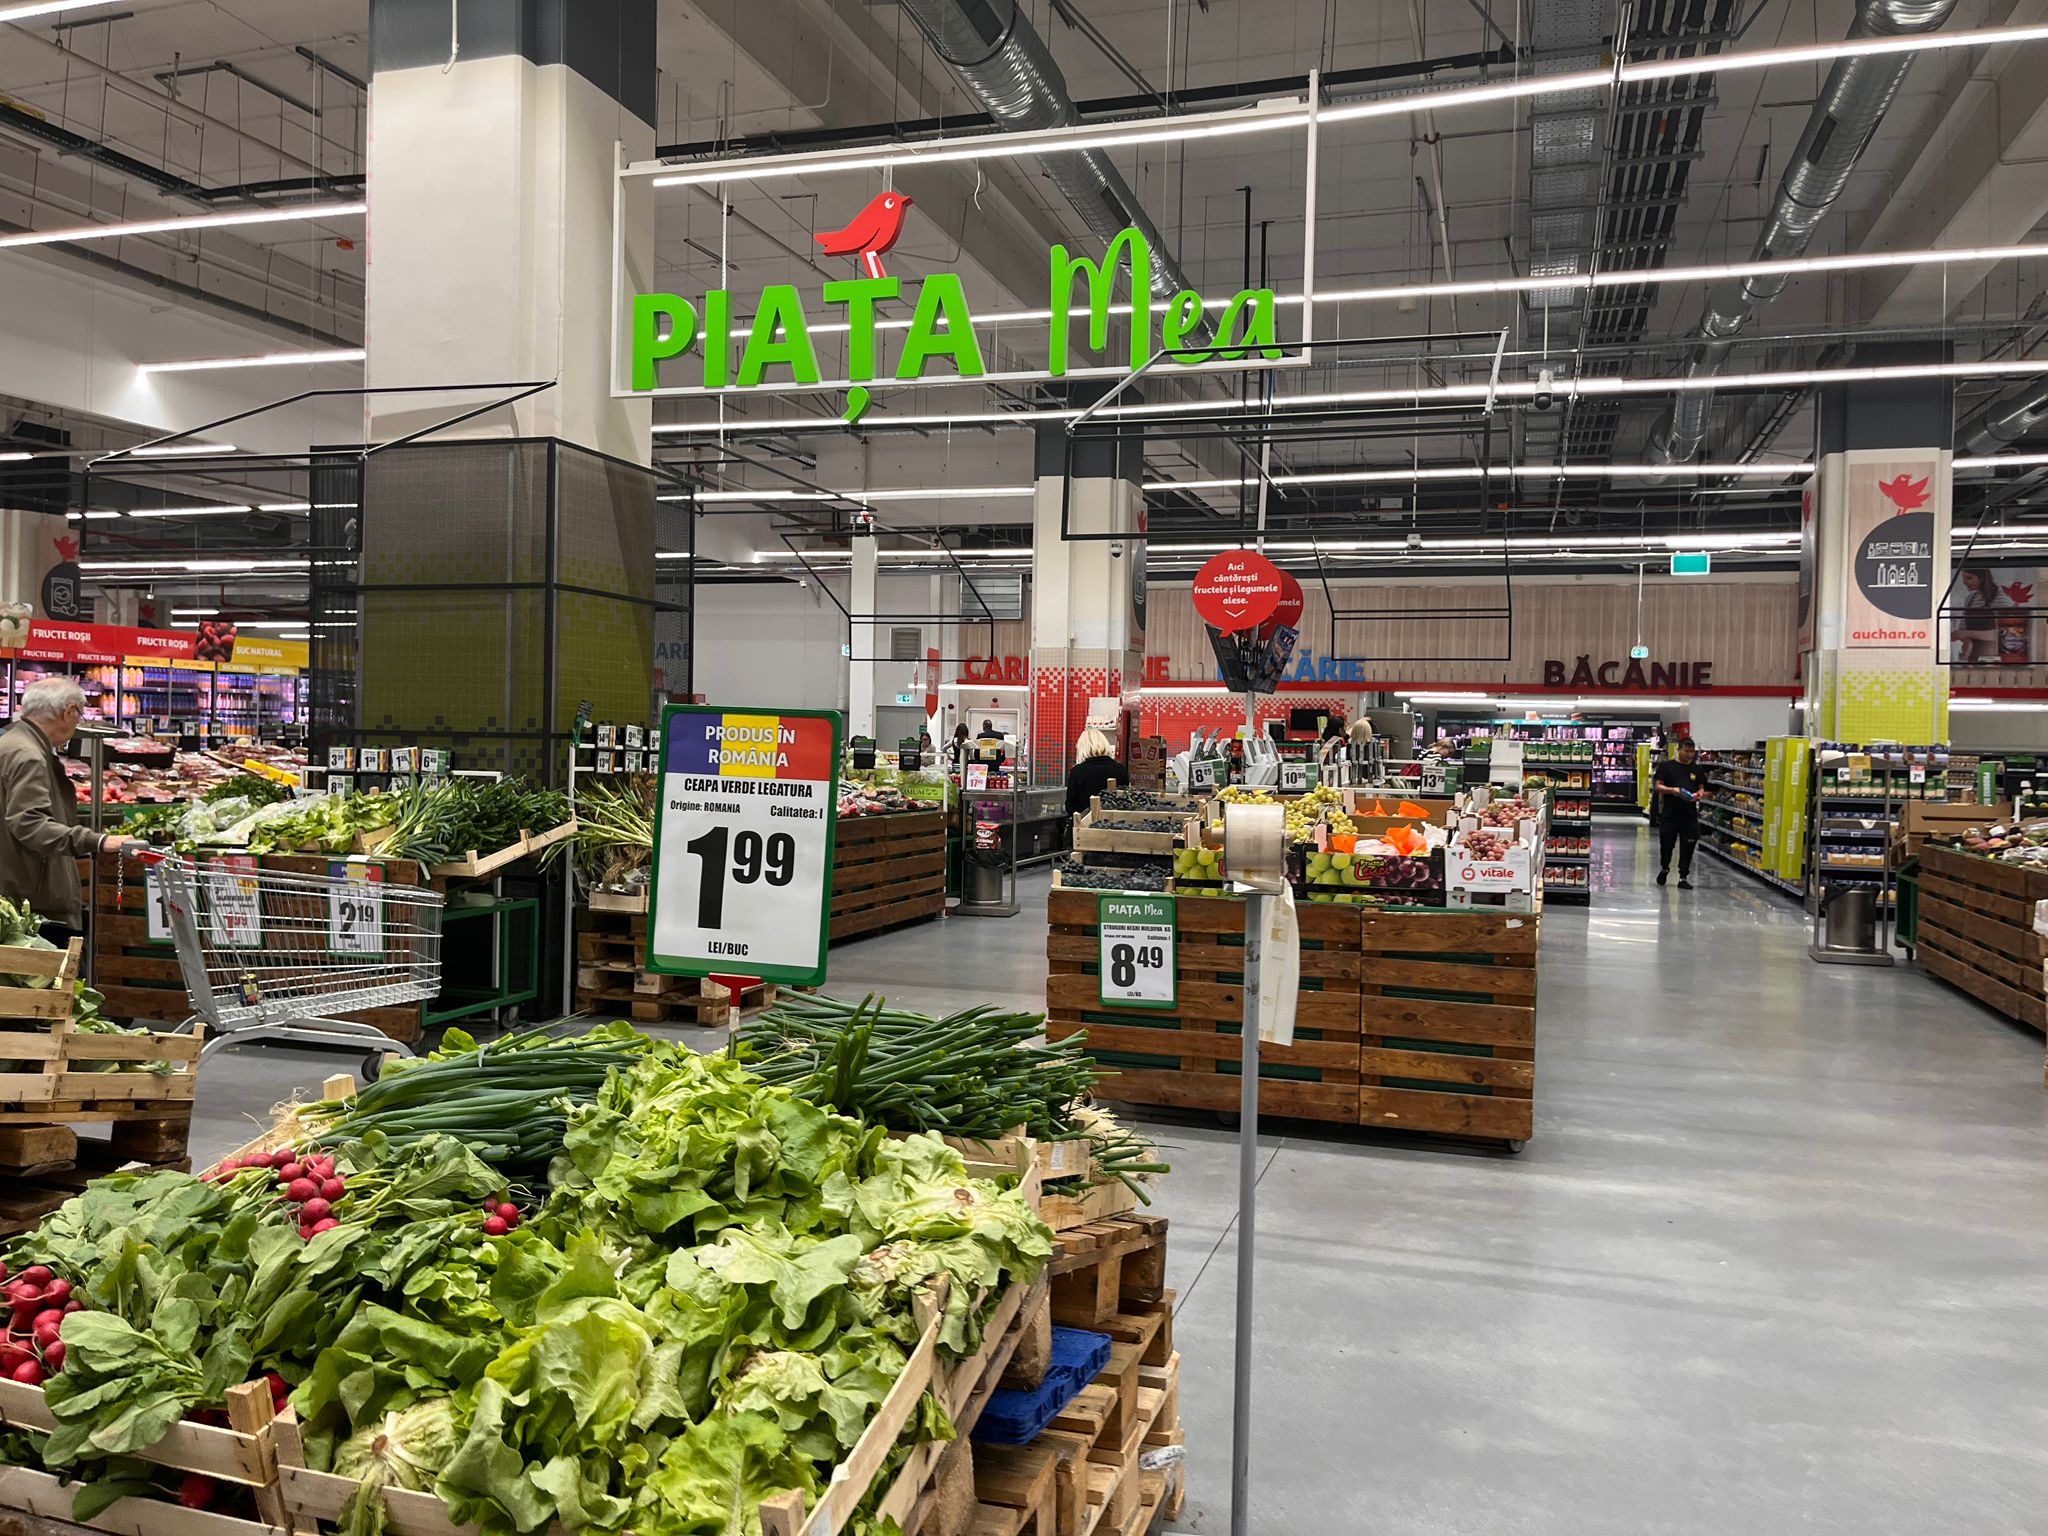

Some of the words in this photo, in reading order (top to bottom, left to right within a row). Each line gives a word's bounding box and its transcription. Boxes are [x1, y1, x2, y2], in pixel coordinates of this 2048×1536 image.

[632, 273, 985, 424] PIAȚA
[1050, 228, 1282, 376] Mea
[1228, 562, 1244, 570] Aici
[1194, 586, 1228, 594] fructele
[1237, 584, 1278, 594] legumele
[33, 628, 67, 640] FRUCTE
[1852, 628, 1926, 640] auchan.ro
[137, 636, 168, 647] FRUCTE
[23, 650, 46, 658] FRUCTE
[77, 653, 99, 662] FRUCTE
[236, 646, 250, 655] SUC
[251, 647, 283, 657] NATURAL
[705, 725, 774, 744] PRODUS
[777, 725, 795, 744] ÎN
[708, 748, 788, 767] ROMÂNIA
[684, 778, 720, 793] CEAPA
[721, 780, 755, 794] VERDE
[758, 782, 812, 798] LEGATURA
[670, 800, 702, 812] Origine:
[704, 802, 740, 813] ROMANIA
[770, 806, 818, 819] Calitatea:
[1481, 868, 1514, 878] vitale
[1108, 904, 1141, 917] PIAȚA
[1144, 904, 1163, 915] Mea
[708, 941, 748, 956] LEI/BUC
